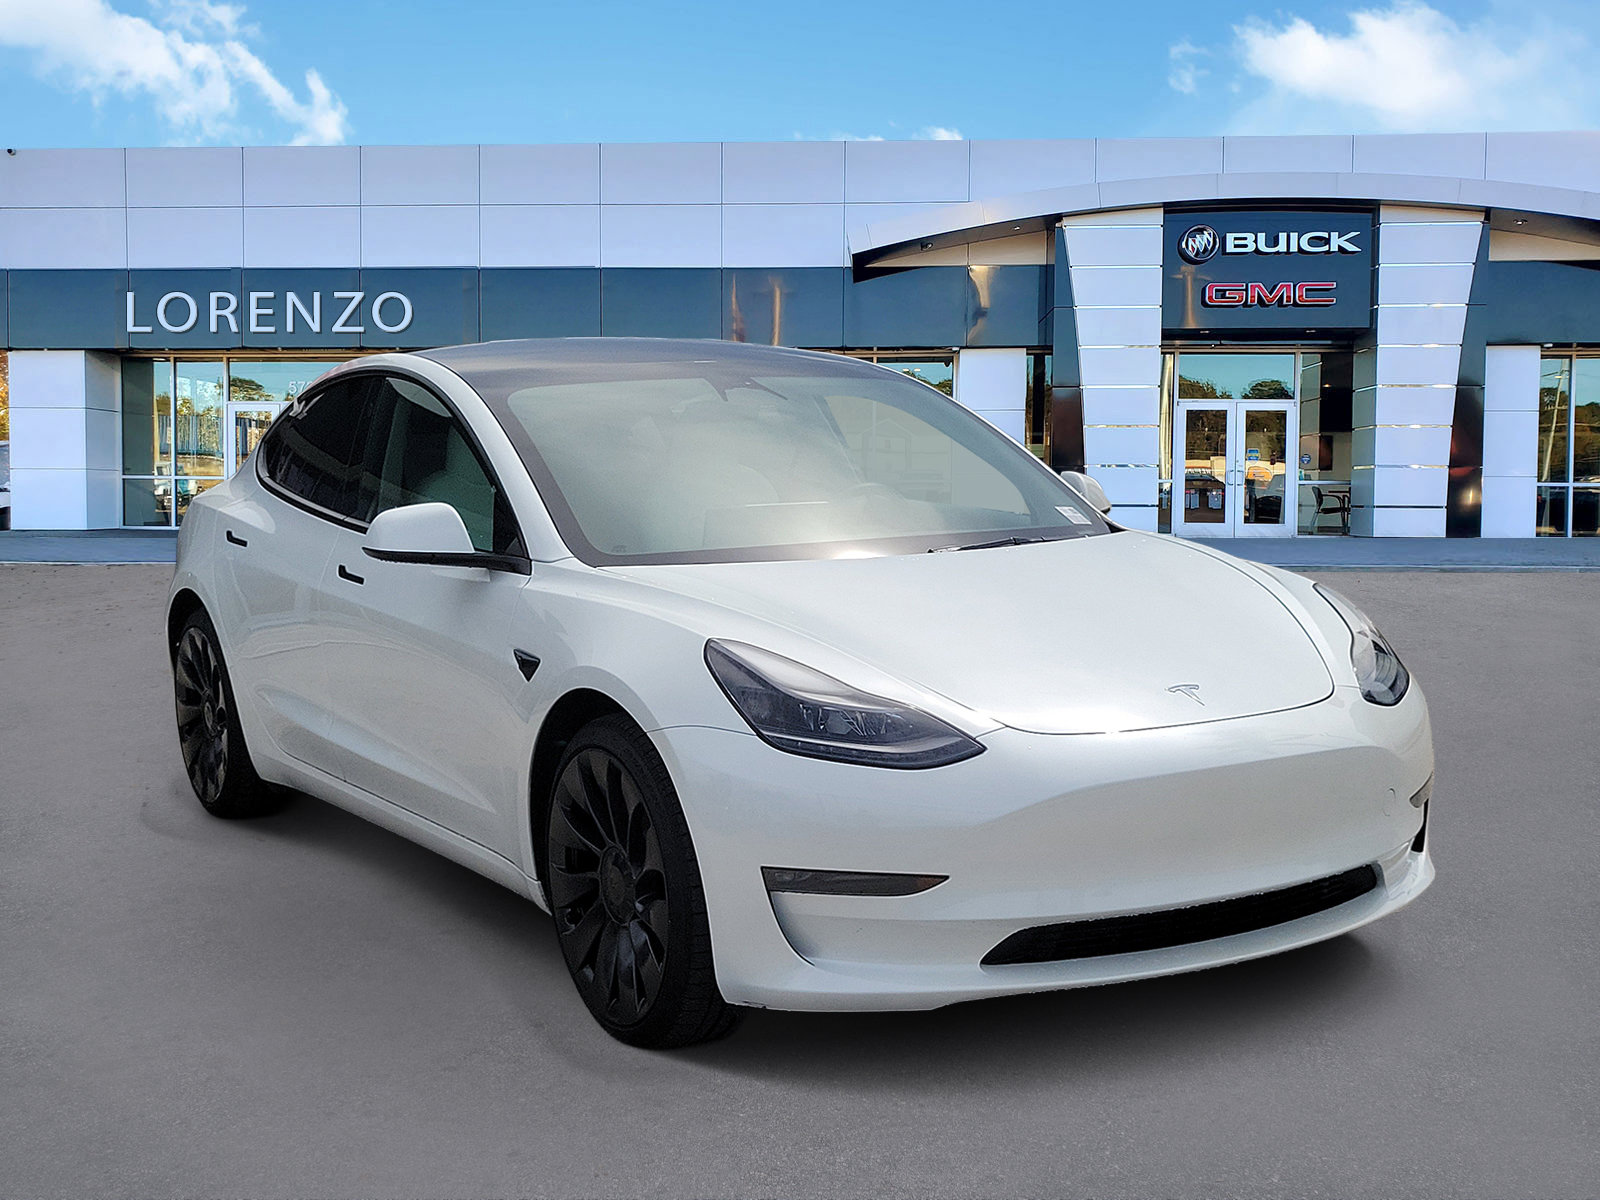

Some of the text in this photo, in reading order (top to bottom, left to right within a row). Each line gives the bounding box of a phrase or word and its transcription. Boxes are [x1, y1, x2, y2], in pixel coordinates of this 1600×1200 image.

[1225, 231, 1362, 253] BUICK
[1205, 282, 1337, 305] GMC
[126, 291, 413, 333] LORENZO
